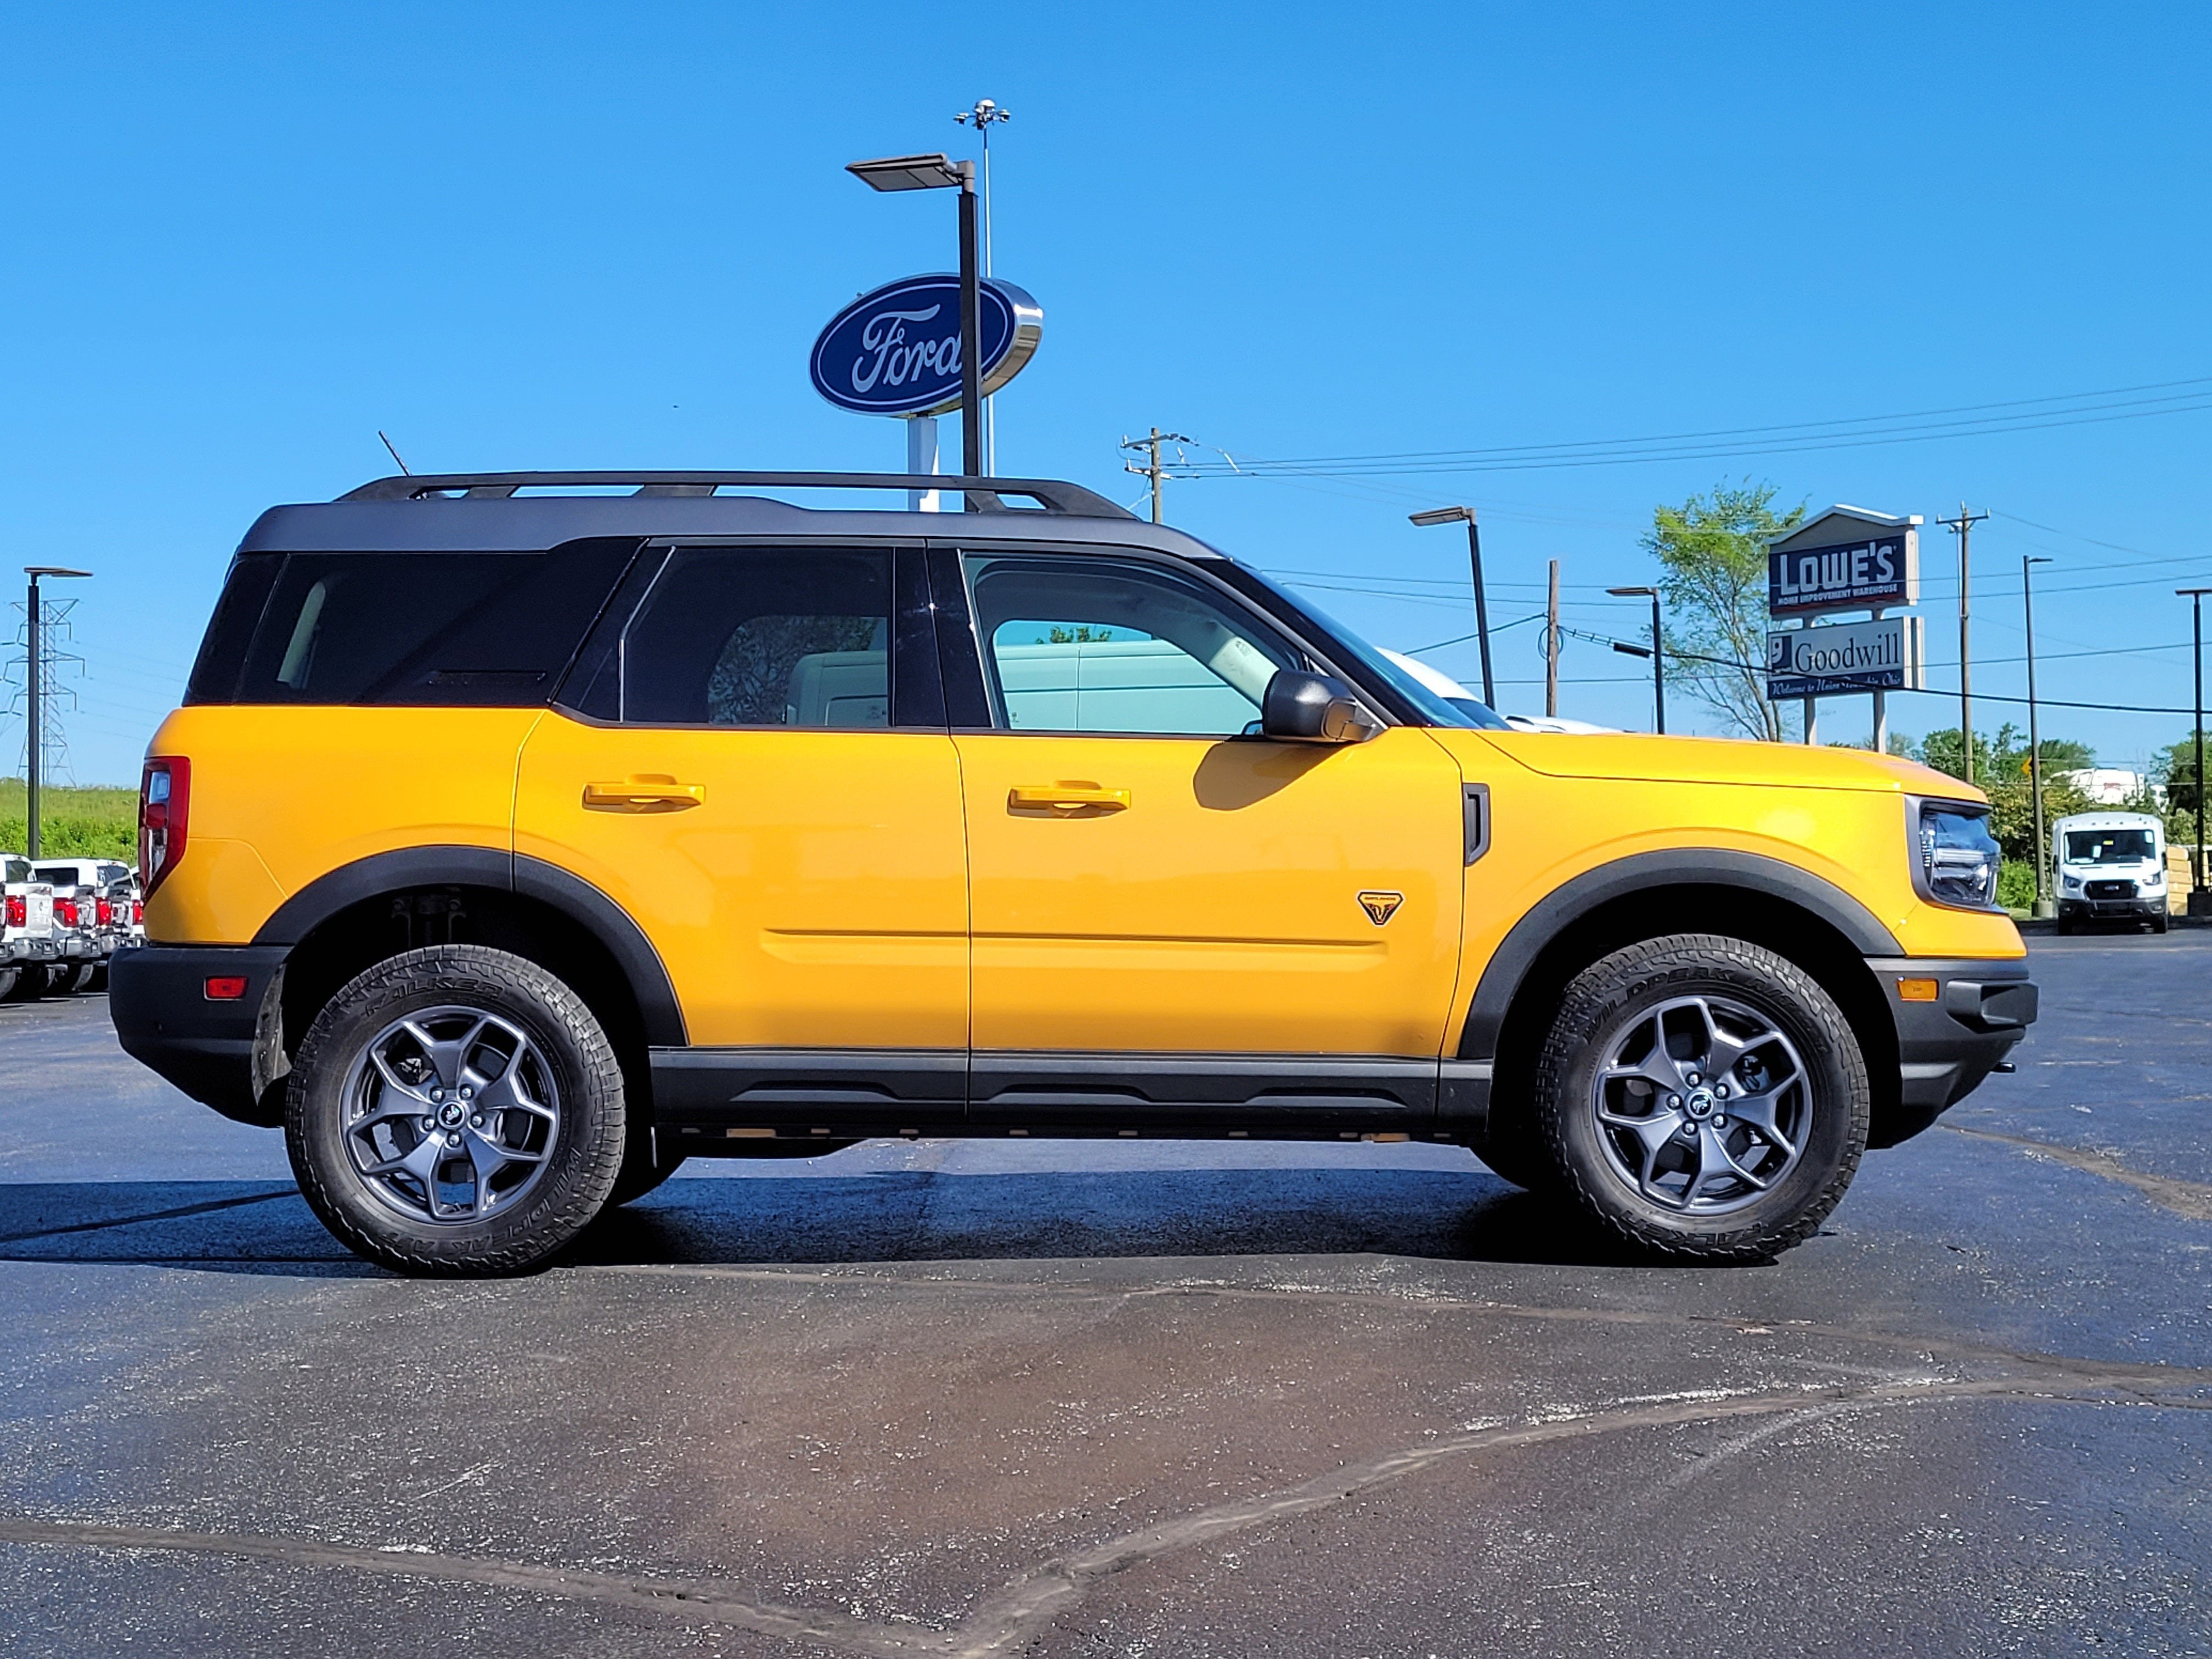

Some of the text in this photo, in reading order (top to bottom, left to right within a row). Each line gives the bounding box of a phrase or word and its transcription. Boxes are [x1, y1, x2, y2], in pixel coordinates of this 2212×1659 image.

[851, 303, 962, 393] Ford
[1779, 541, 1895, 596] LOWE'S
[1778, 584, 1898, 605] HOME IMPROVEMENT WAREHOUSE
[1795, 633, 1900, 672] Goodwill
[363, 977, 505, 1017] FALKEN
[1582, 967, 1735, 1044] WILDPEAK
